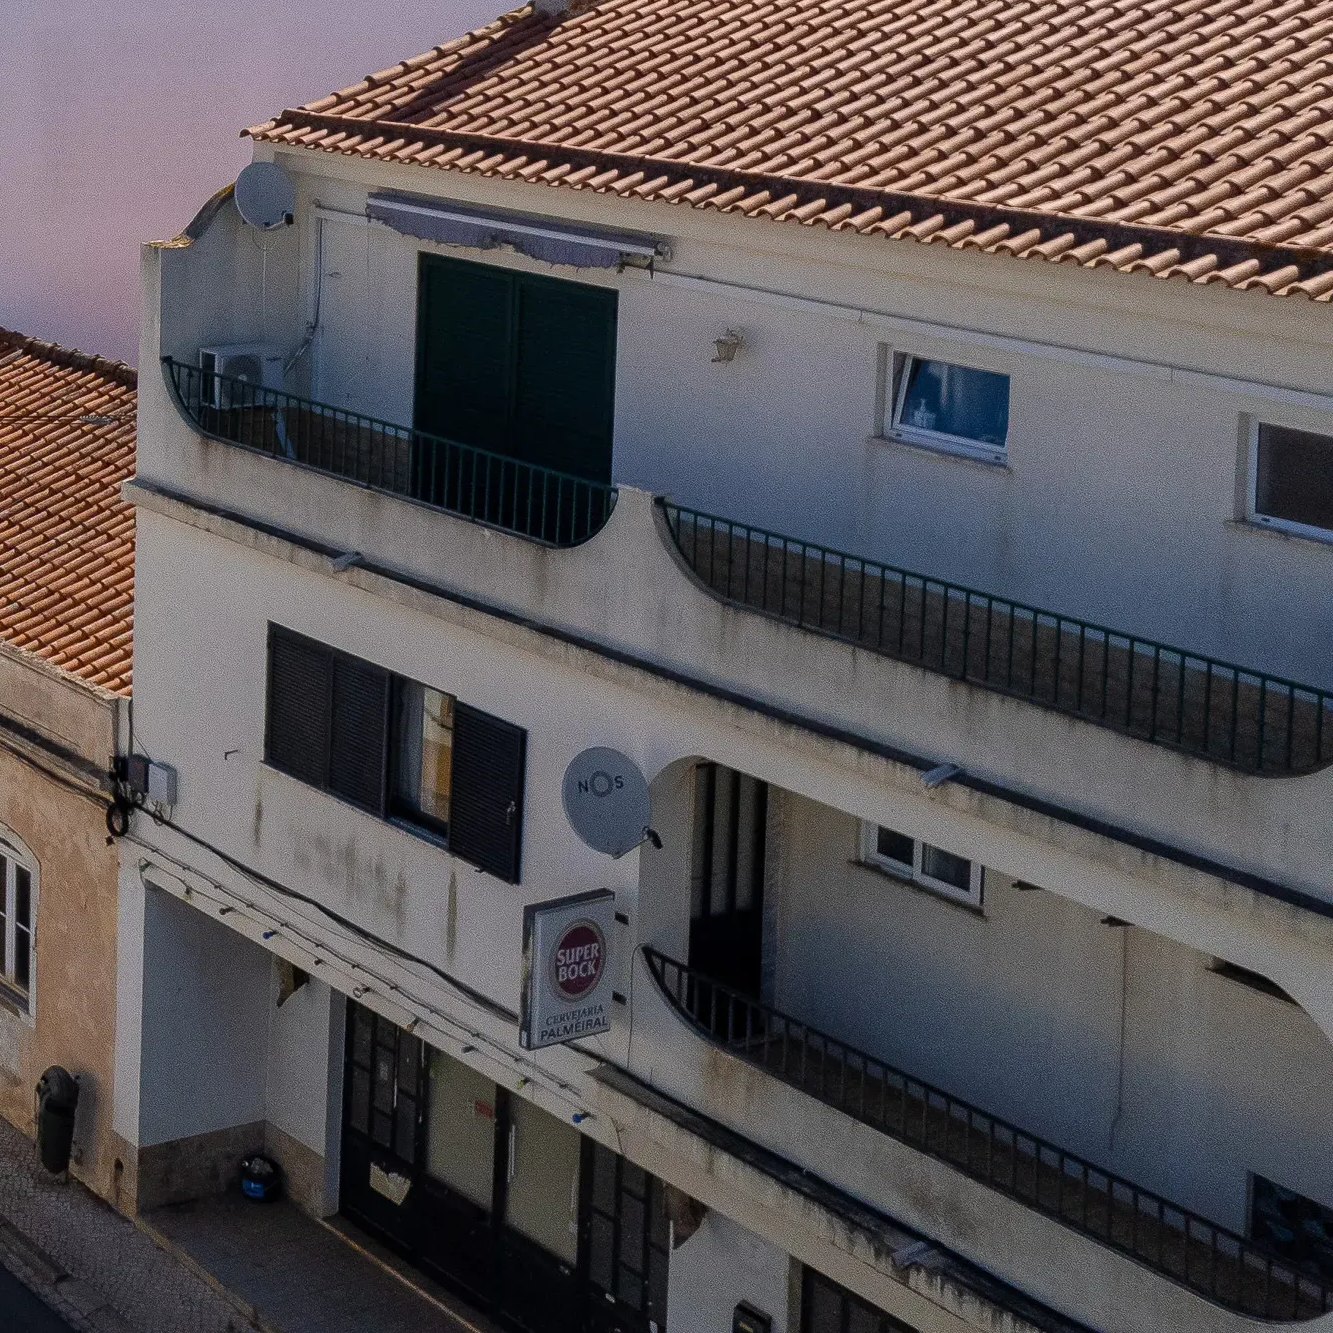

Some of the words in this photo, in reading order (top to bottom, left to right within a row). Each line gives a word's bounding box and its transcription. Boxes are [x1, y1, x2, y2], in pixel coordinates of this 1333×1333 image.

[577, 770, 624, 798] NOS
[556, 942, 600, 966] SUPER
[558, 959, 597, 982] BOCK
[545, 1004, 604, 1026] CERVEJARIA
[540, 1015, 609, 1041] PALMEIRAL
